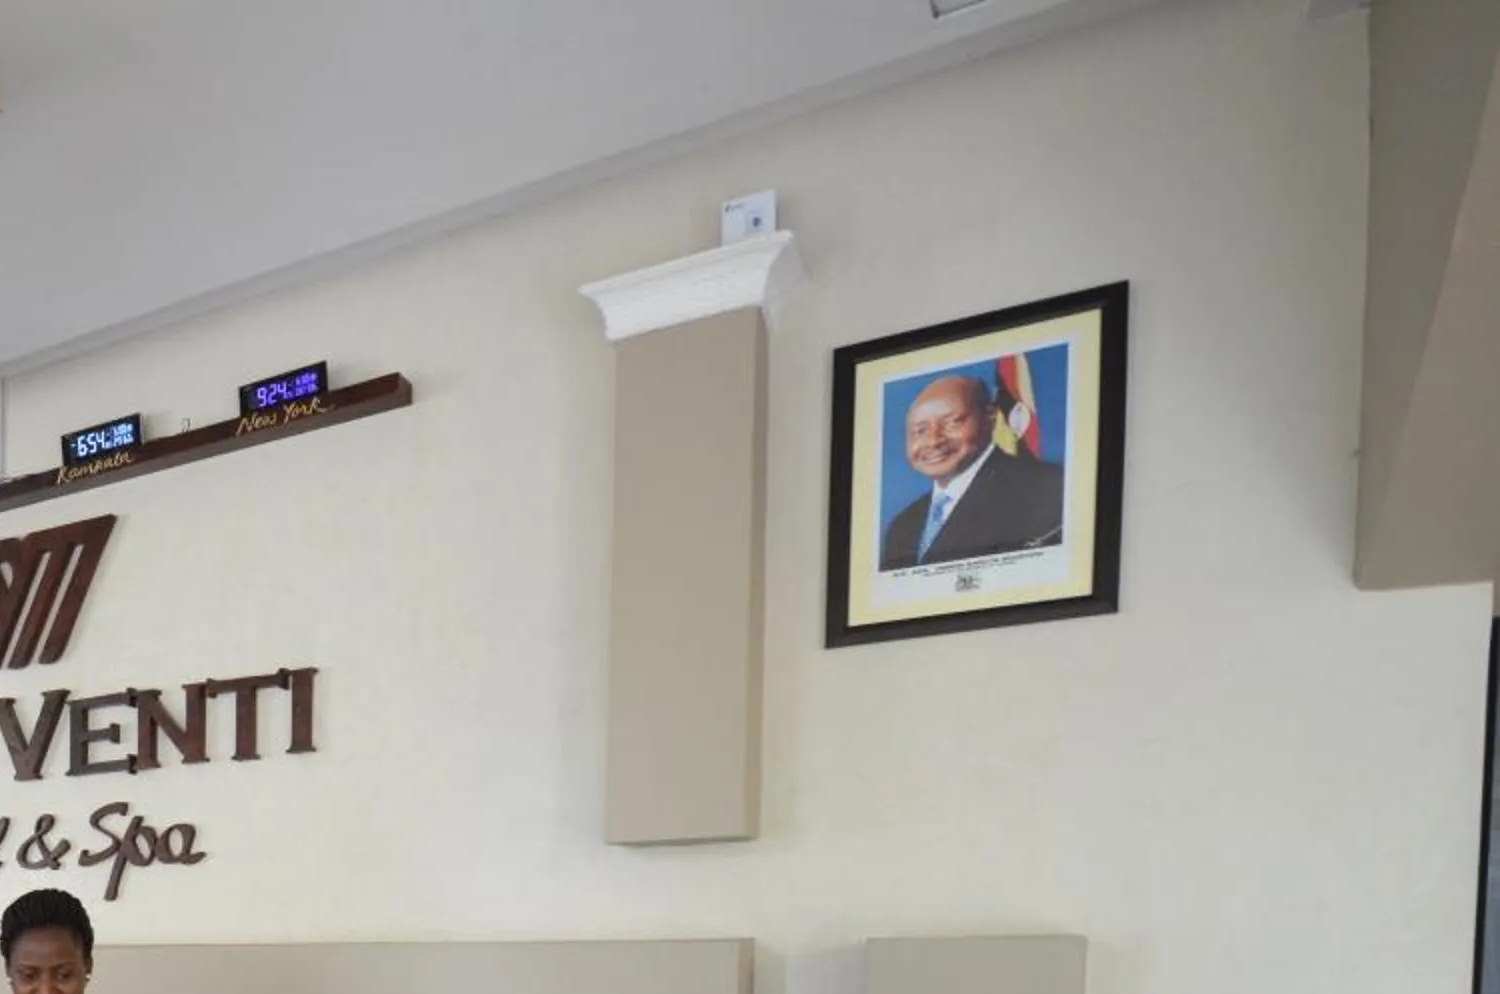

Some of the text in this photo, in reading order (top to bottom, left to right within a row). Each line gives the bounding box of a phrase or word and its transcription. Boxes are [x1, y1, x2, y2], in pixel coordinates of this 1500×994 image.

[282, 397, 336, 426] York
[57, 451, 134, 484] Kampala
[16, 812, 71, 871] &
[77, 800, 207, 901] Spa
